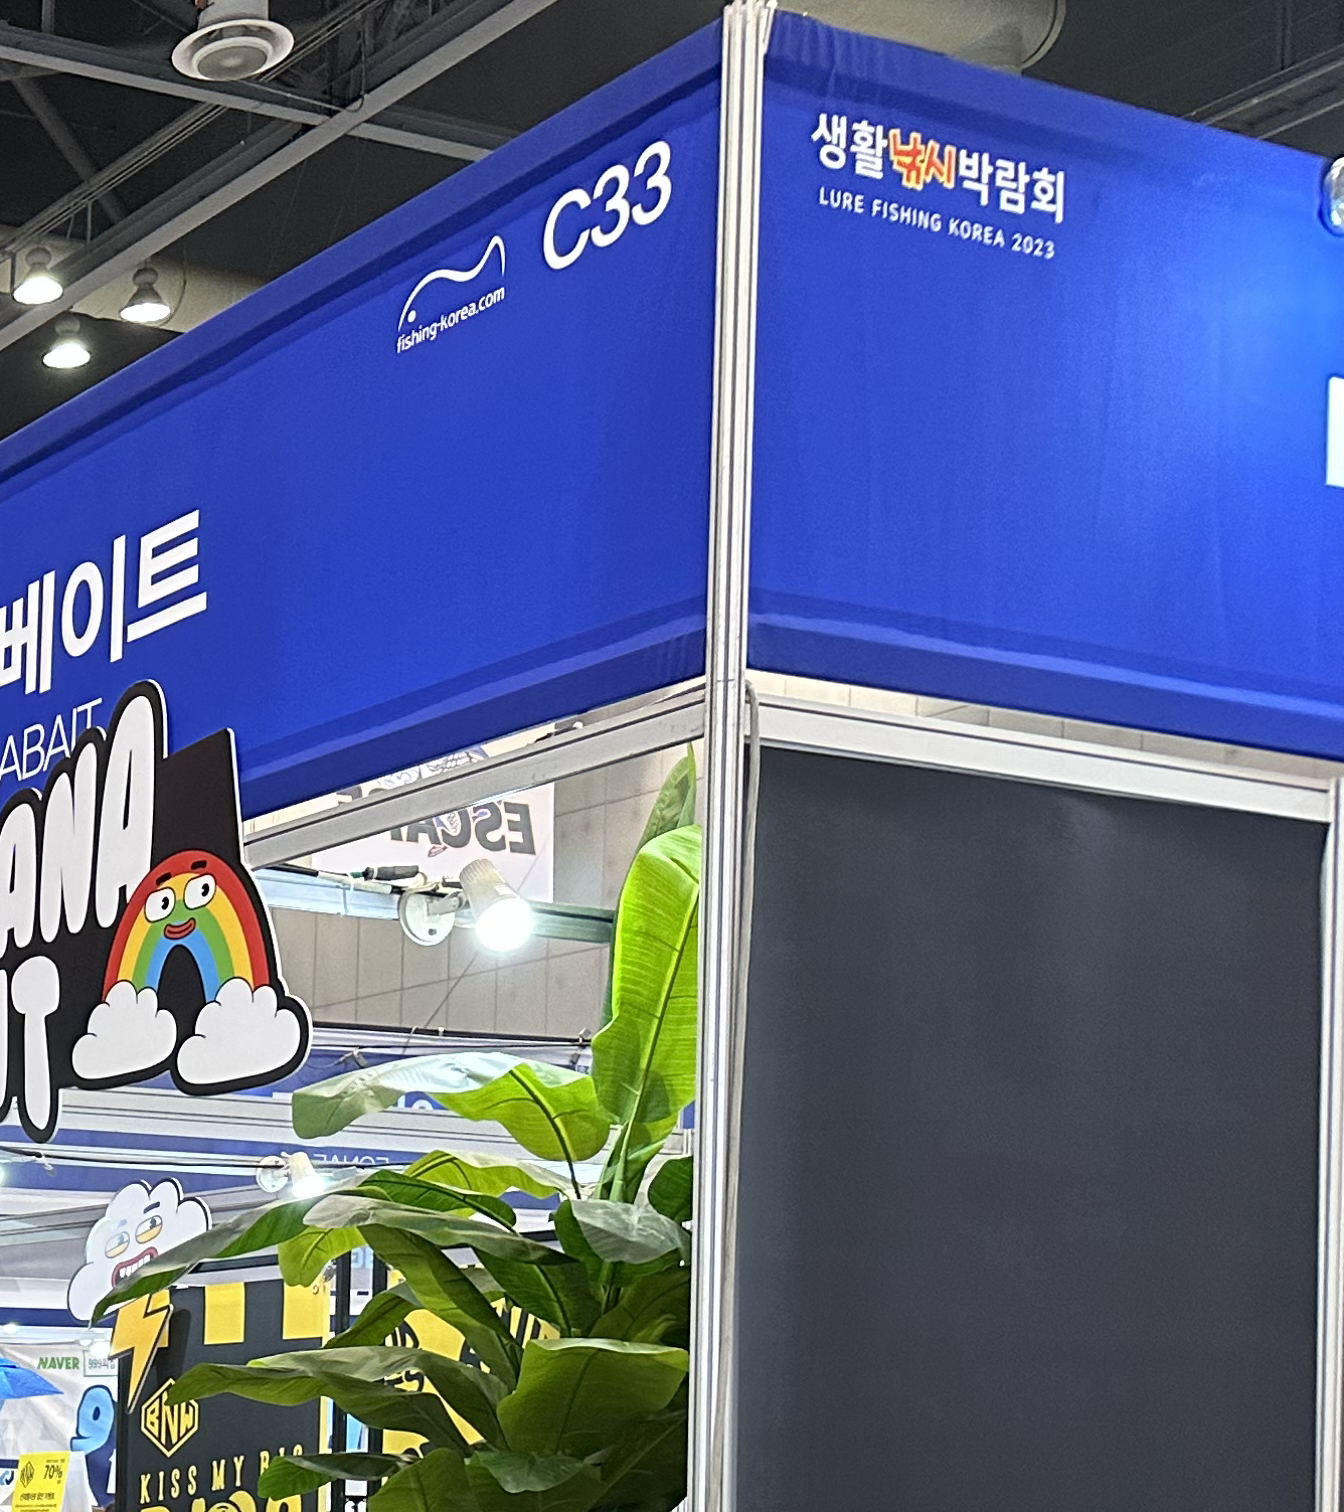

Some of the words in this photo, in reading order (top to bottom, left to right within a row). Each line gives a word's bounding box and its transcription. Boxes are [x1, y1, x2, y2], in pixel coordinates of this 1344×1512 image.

[811, 112, 1065, 224] 생활낚시박람회
[543, 139, 672, 270] C33
[819, 187, 865, 214] LURE
[871, 197, 942, 232] FISHING
[948, 216, 1006, 248] KOREA
[1011, 233, 1056, 260] 2023
[396, 285, 506, 355] fishing-korea.com
[37, 1356, 80, 1371] NAVER
[139, 1464, 198, 1504] KISS
[211, 1454, 245, 1491] MY
